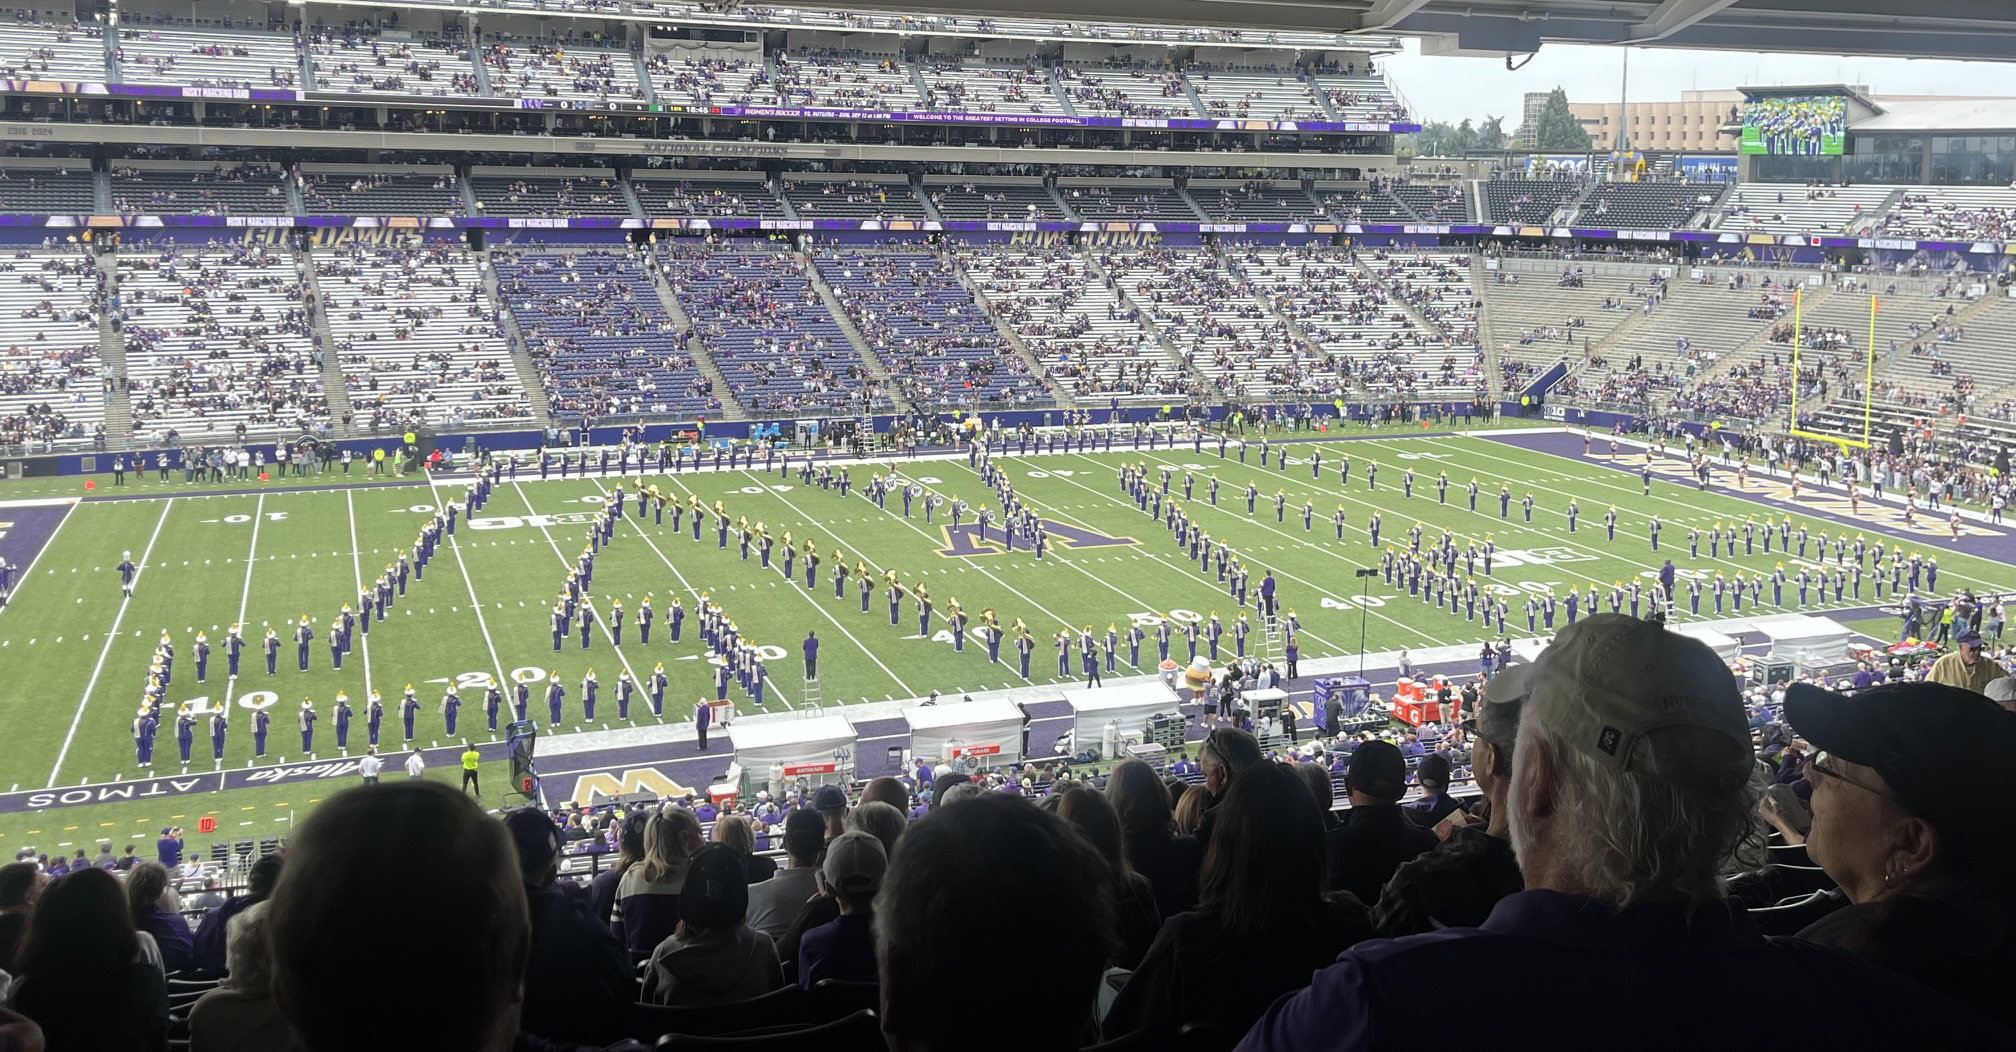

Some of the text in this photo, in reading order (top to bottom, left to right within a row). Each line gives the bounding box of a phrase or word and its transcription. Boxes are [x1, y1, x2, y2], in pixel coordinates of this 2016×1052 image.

[744, 108, 774, 116] WOMEN'S
[643, 142, 708, 153] NATIONAL
[712, 144, 788, 156] CHAMPIONS
[1698, 162, 1720, 173] RUN
[226, 217, 294, 227] HUSKY MARCHING BAND
[244, 226, 425, 248] GO DAWGS
[1769, 246, 1796, 262] W
[1026, 470, 1074, 478] 40
[223, 512, 288, 523] 10
[932, 518, 1145, 558] W
[1320, 594, 1386, 610] 40
[1127, 608, 1204, 626] 50
[449, 666, 547, 690] 20
[184, 691, 279, 716] 10
[1397, 706, 1403, 716] G
[1410, 710, 1419, 724] G
[246, 758, 386, 782] Alaska
[1184, 764, 1188, 774] 1
[27, 778, 200, 807] ATMOS
[560, 767, 698, 810] W
[201, 818, 211, 830] 10
